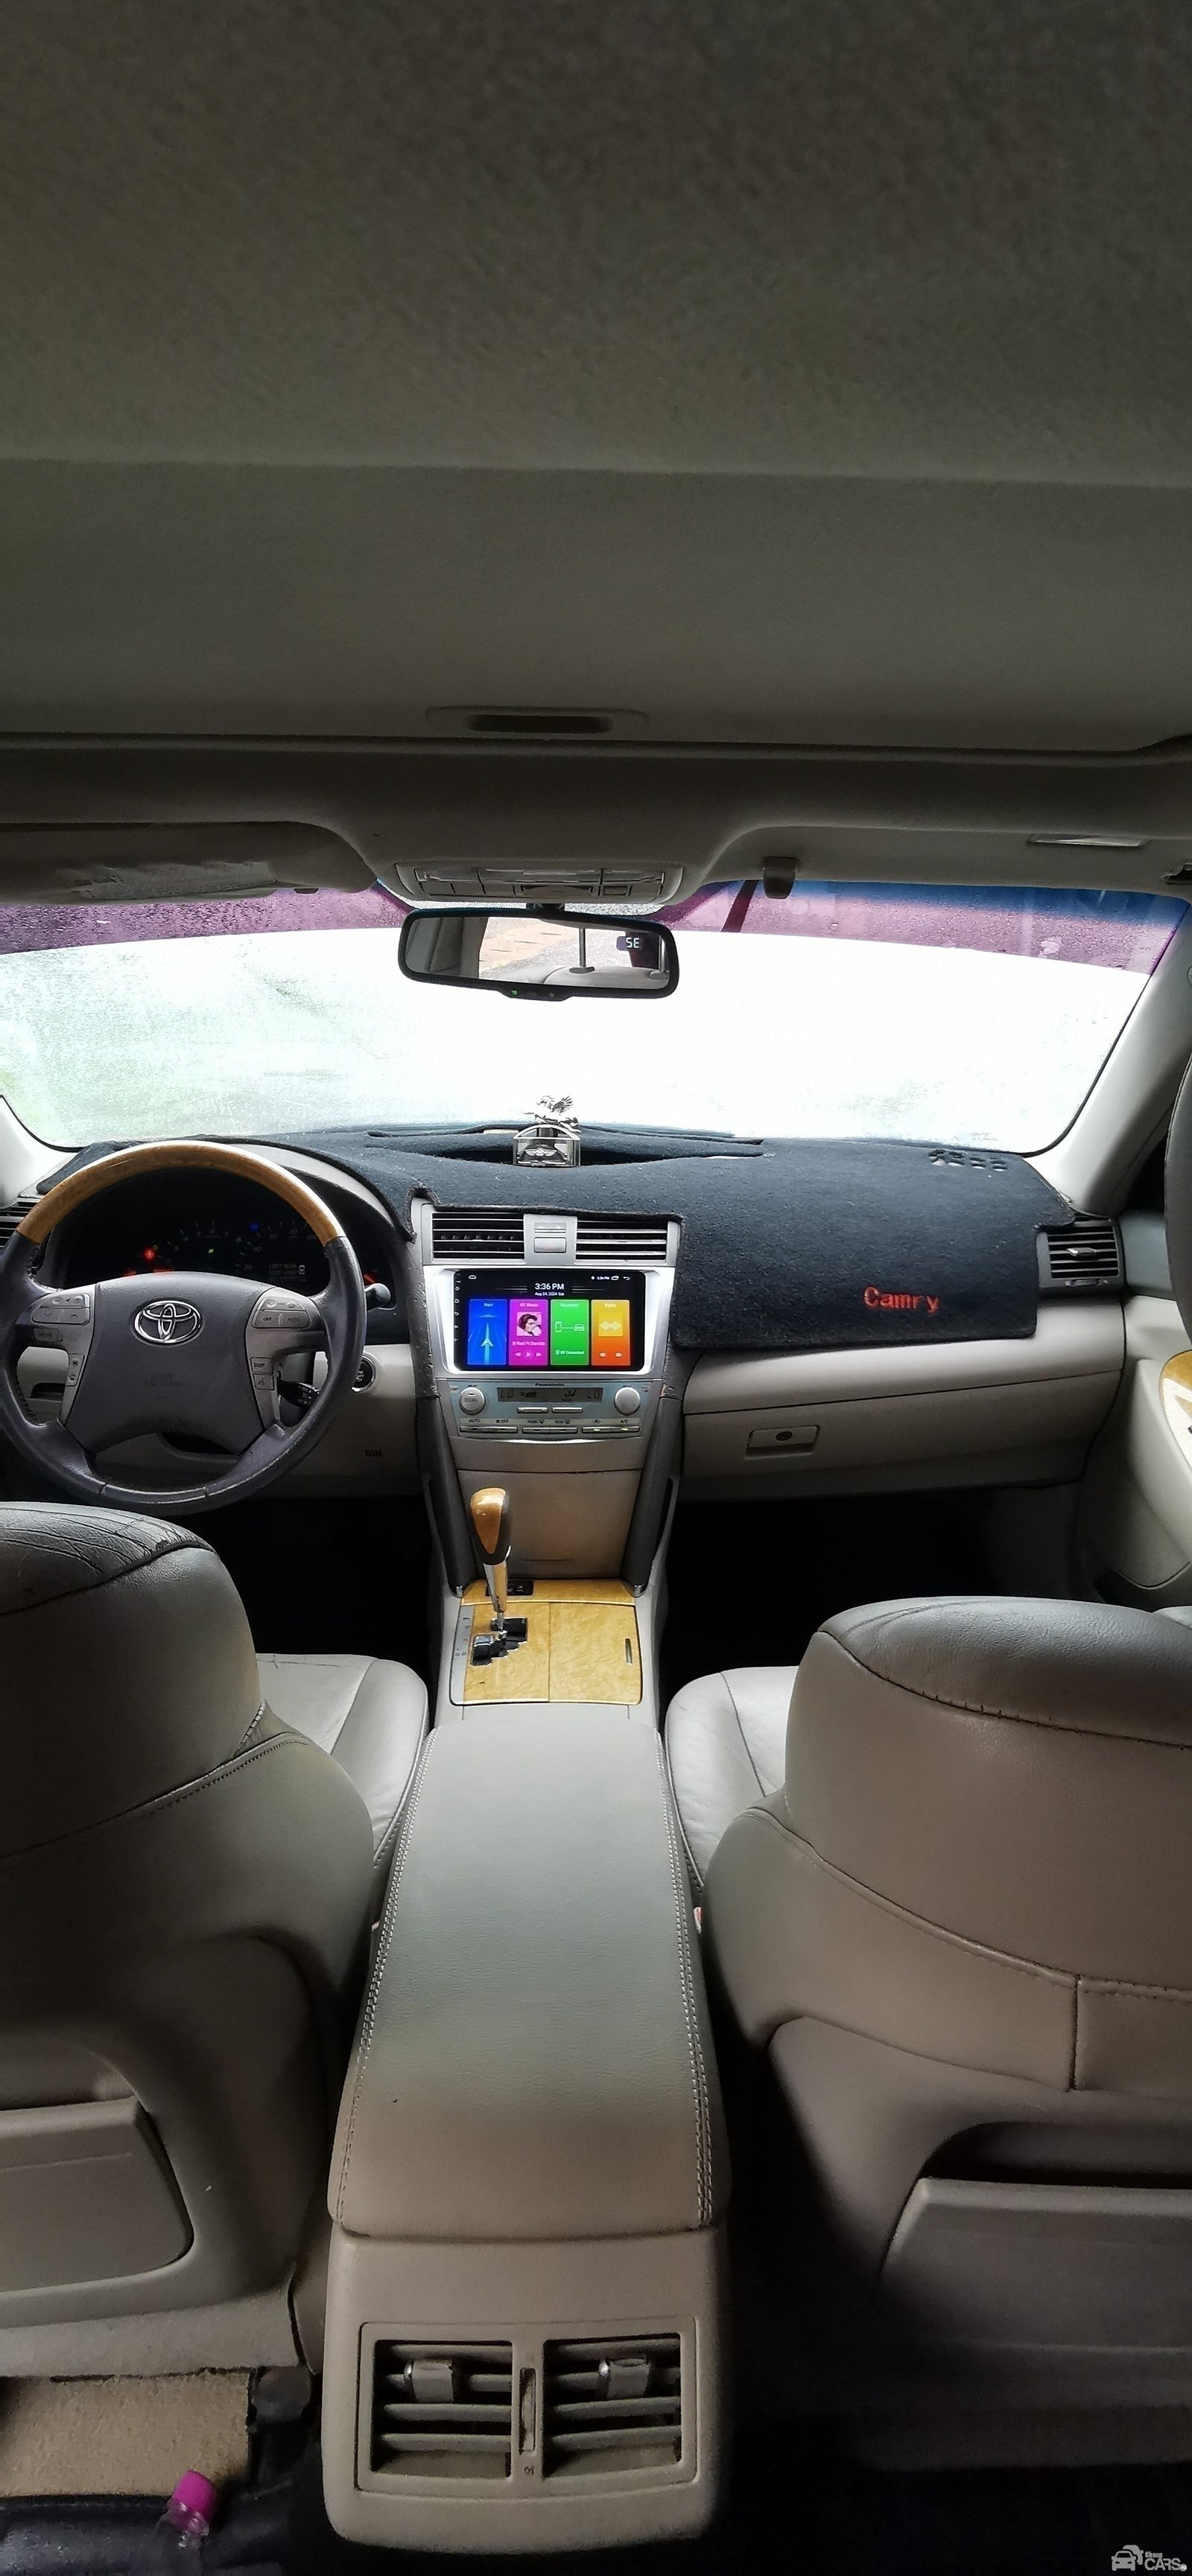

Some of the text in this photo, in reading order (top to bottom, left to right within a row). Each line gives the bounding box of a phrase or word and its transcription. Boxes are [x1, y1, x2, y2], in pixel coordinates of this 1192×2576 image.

[626, 937, 640, 949] SE
[534, 1282, 565, 1291] 3:36 PM
[863, 1286, 940, 1314] Camry
